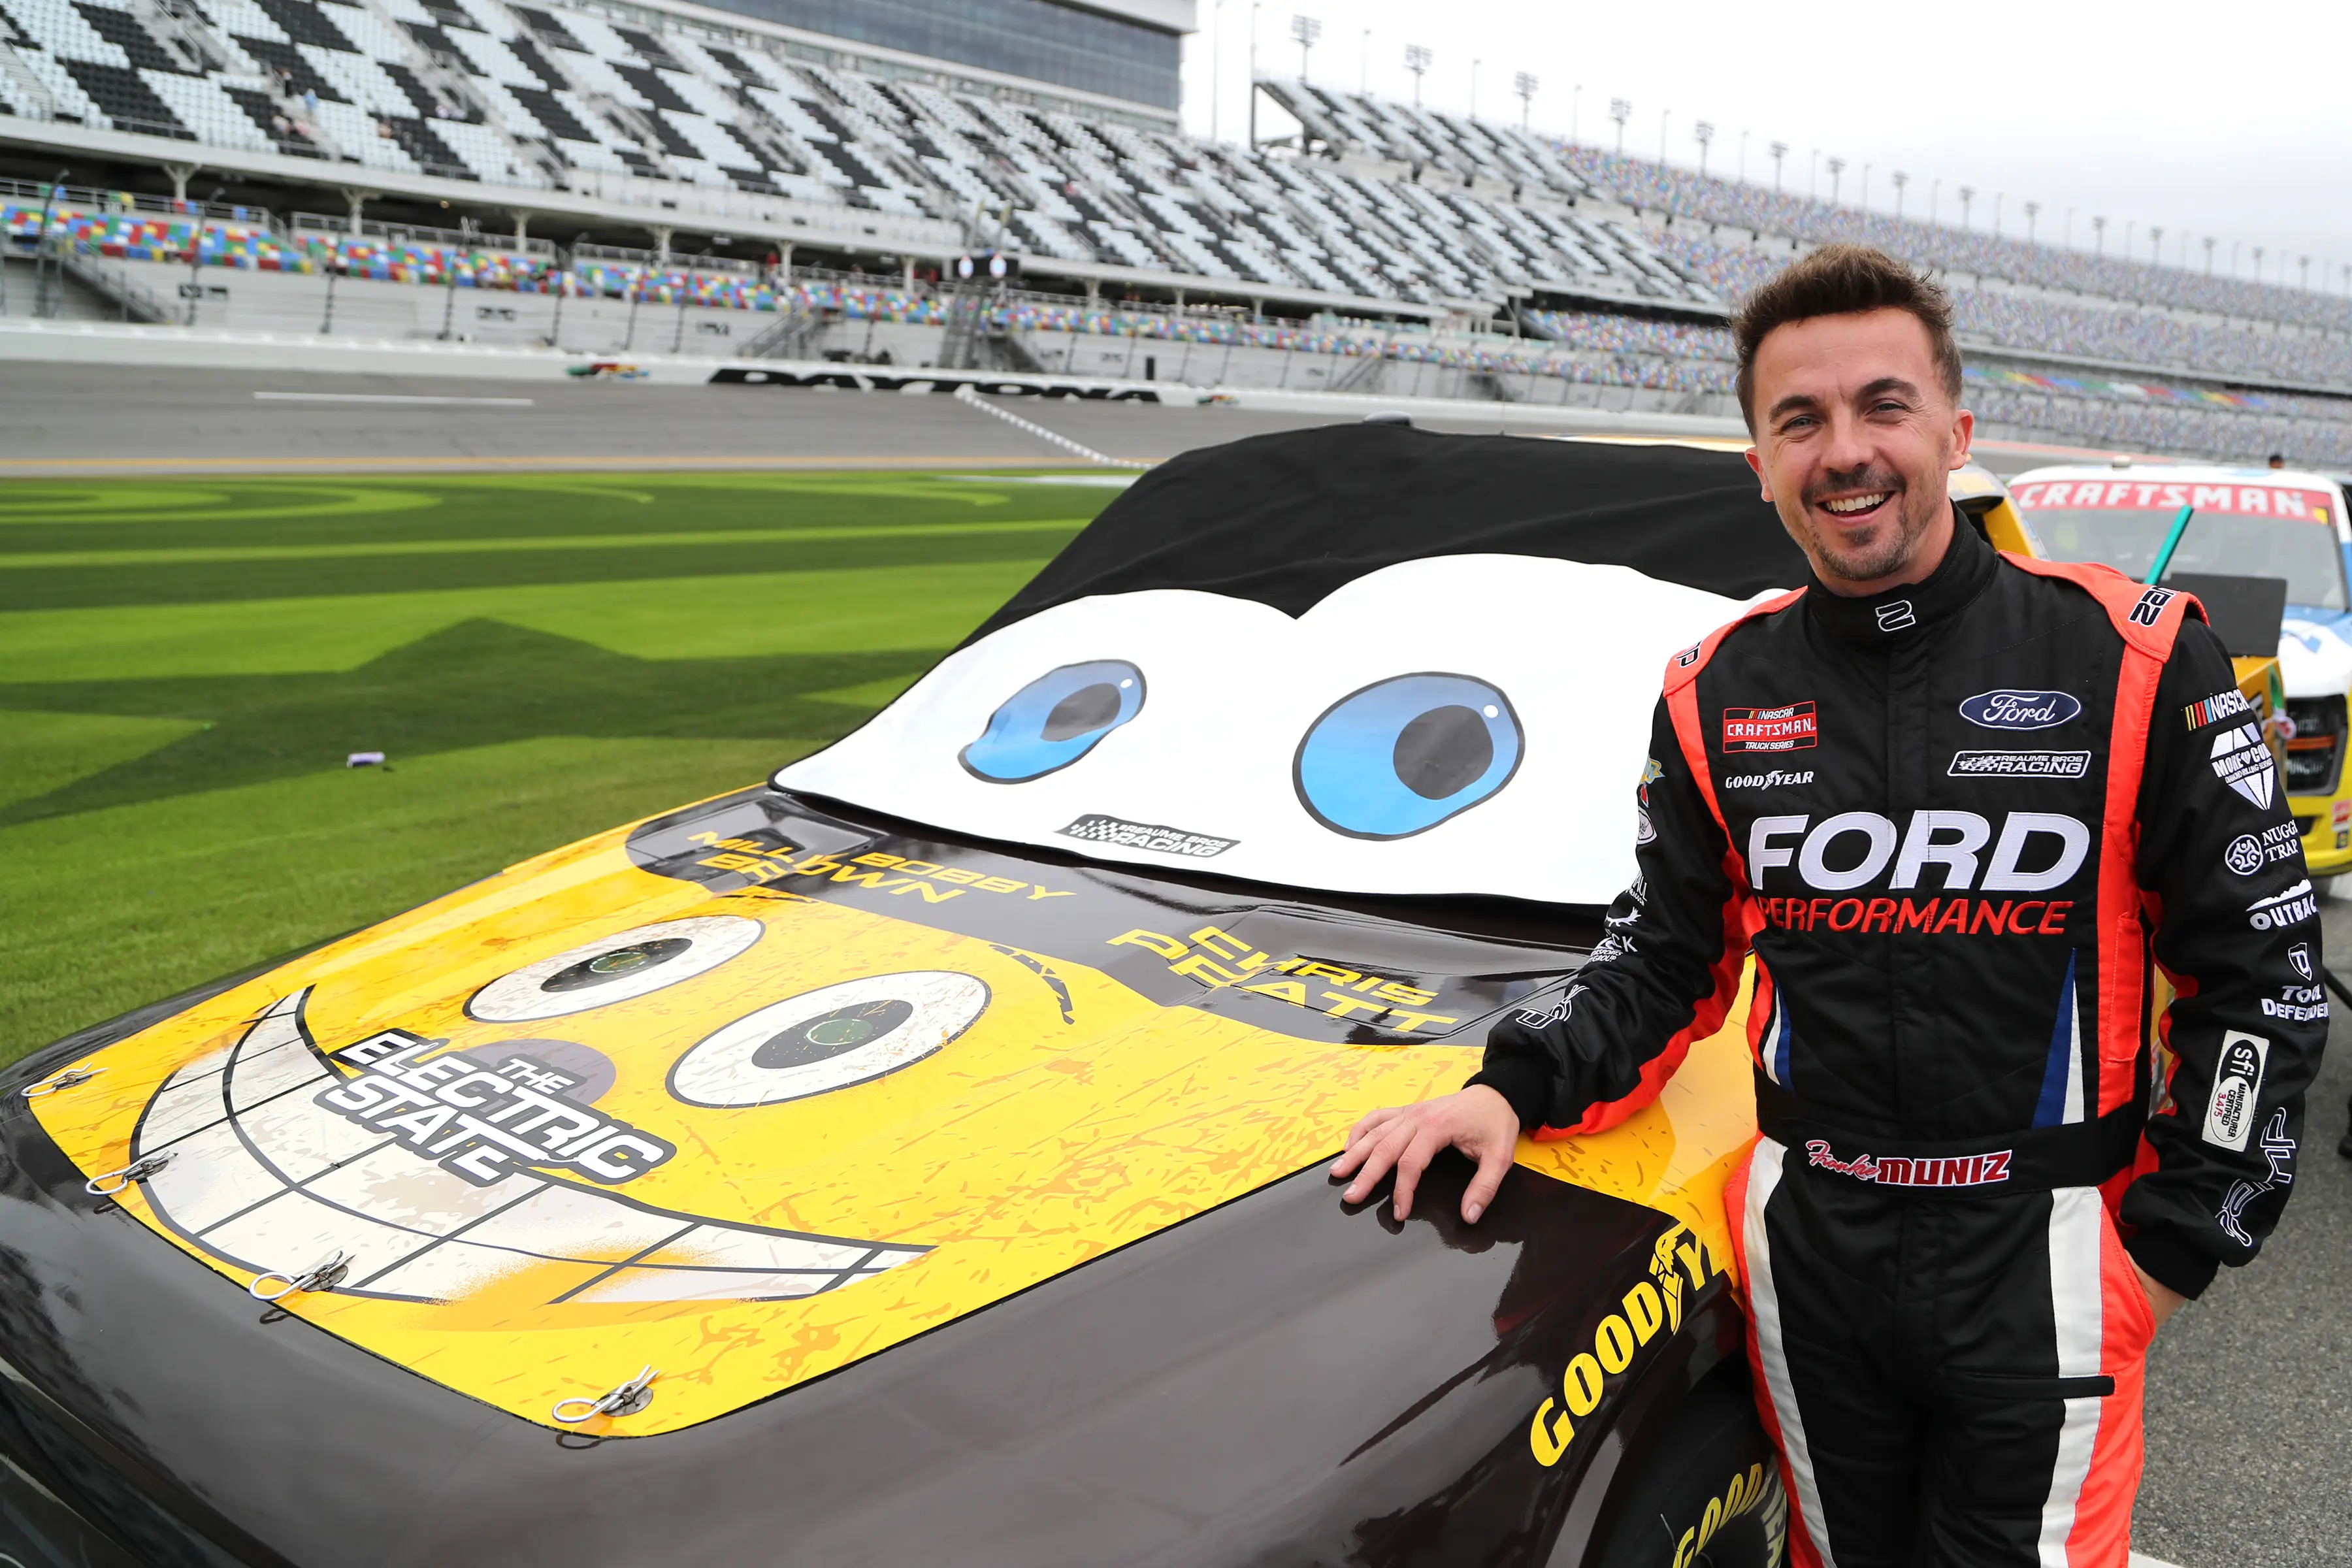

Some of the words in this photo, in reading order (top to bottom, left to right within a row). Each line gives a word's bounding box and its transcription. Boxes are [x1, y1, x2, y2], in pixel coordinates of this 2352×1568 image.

[2020, 482, 2306, 517] CRAFTSMAN
[1761, 707, 1794, 719] NASCAR
[1983, 694, 2056, 722] Ford
[2210, 689, 2249, 721] NASCA
[1727, 718, 1812, 736] CRAFTSMAN
[1769, 740, 1795, 749] SERIES
[1725, 770, 1814, 791] GOODYEAR
[1997, 761, 2082, 773] RACING
[1109, 832, 1221, 857] RACING
[1124, 825, 1186, 841] REAUME
[1185, 833, 1230, 848] BROS
[1748, 810, 2089, 891] FORD
[696, 853, 967, 904] BROWN
[851, 852, 1077, 900] BOBBY
[1757, 897, 2074, 935] PERFORMANCE
[2249, 893, 2319, 930] OUTBAC
[1105, 928, 1459, 1032] PRATT
[1188, 926, 1439, 1006] CHRIS
[2261, 1002, 2328, 1021] DEFENDE
[497, 1058, 576, 1095] THE
[2229, 1047, 2255, 1077] sfi
[337, 1032, 664, 1179] ELECTRIC
[2221, 1089, 2236, 1126] CERTIFIED
[2227, 1083, 2247, 1138] MANUFACTURER
[325, 1074, 544, 1181] STATE
[1805, 1139, 1882, 1181] Frankie
[1874, 1149, 2012, 1186] MUNIZ
[1530, 1222, 1733, 1467] GOODYE
